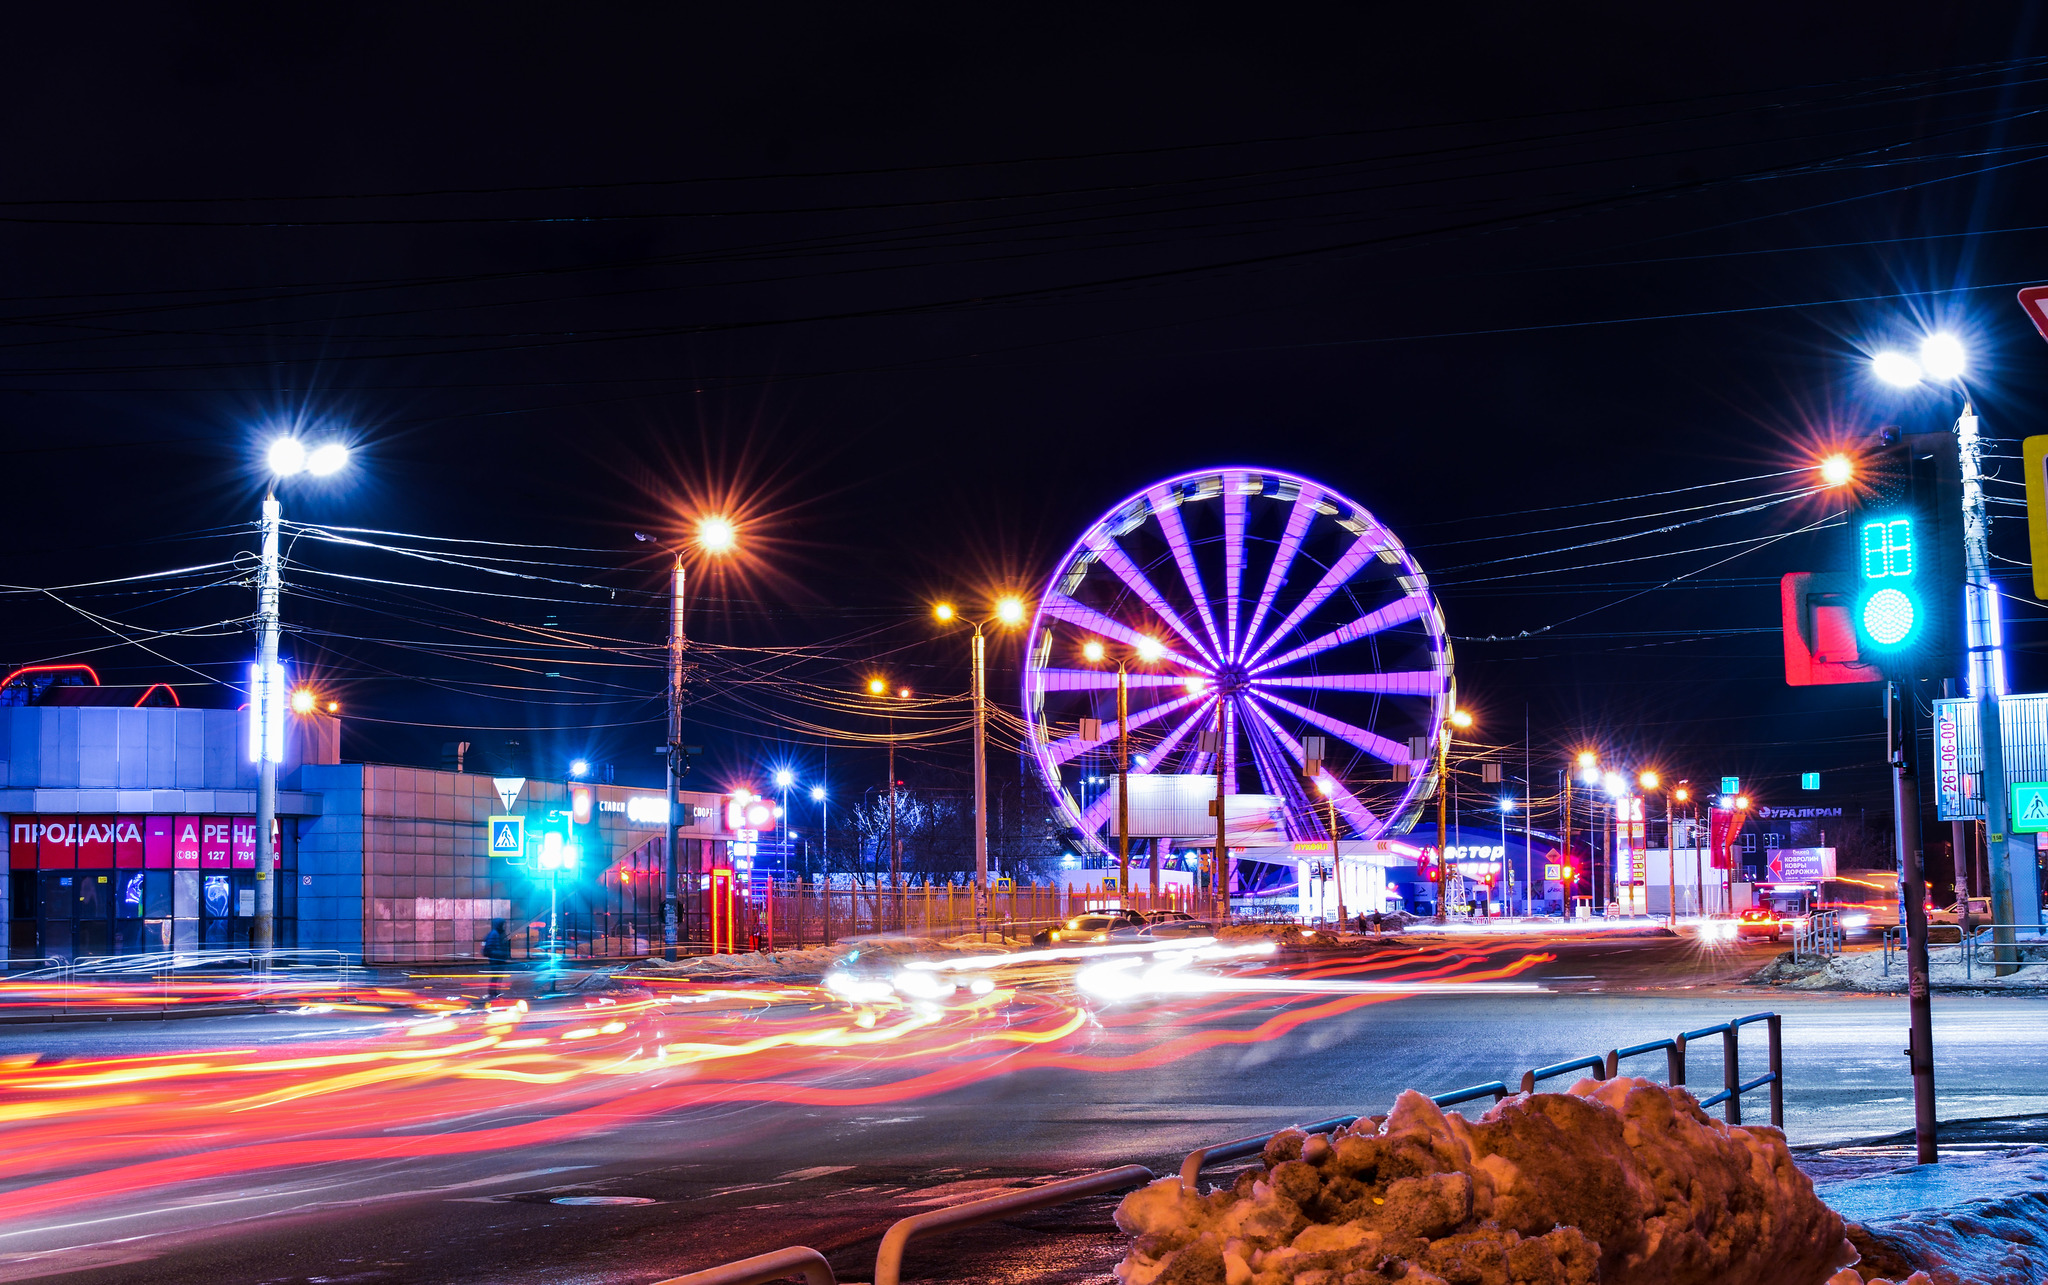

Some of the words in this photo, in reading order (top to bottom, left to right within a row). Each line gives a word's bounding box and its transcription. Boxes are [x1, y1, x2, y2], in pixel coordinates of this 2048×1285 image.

[1941, 723, 1957, 792] 261-06-00
[1771, 808, 1842, 818] УРАЛКРАН
[14, 823, 142, 847] ПРОДАЖА
[208, 851, 225, 860] 127
